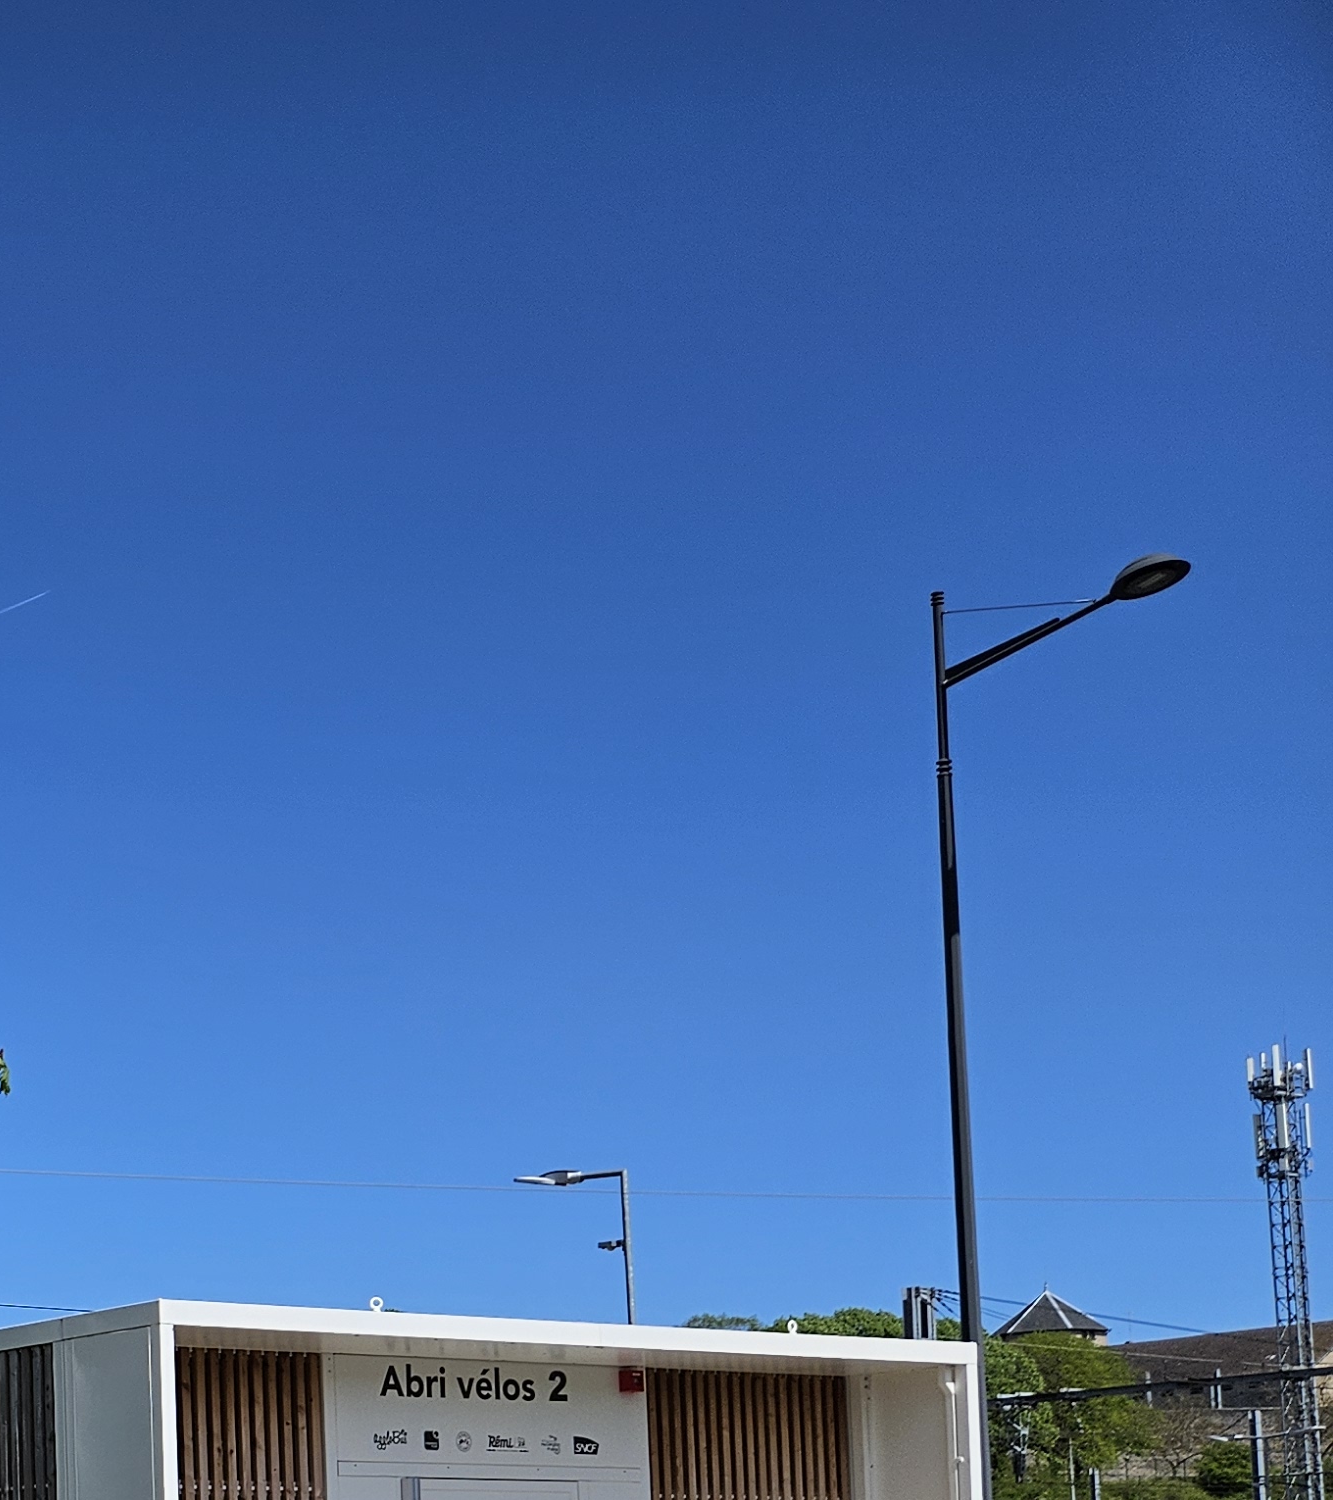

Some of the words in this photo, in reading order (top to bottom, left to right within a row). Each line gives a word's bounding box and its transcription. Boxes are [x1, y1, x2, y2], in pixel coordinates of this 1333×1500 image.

[380, 1364, 446, 1398] Abri
[456, 1367, 536, 1401] vélos
[548, 1370, 568, 1402] 2
[488, 1435, 515, 1448] Rémi
[575, 1442, 598, 1454] SNCF
